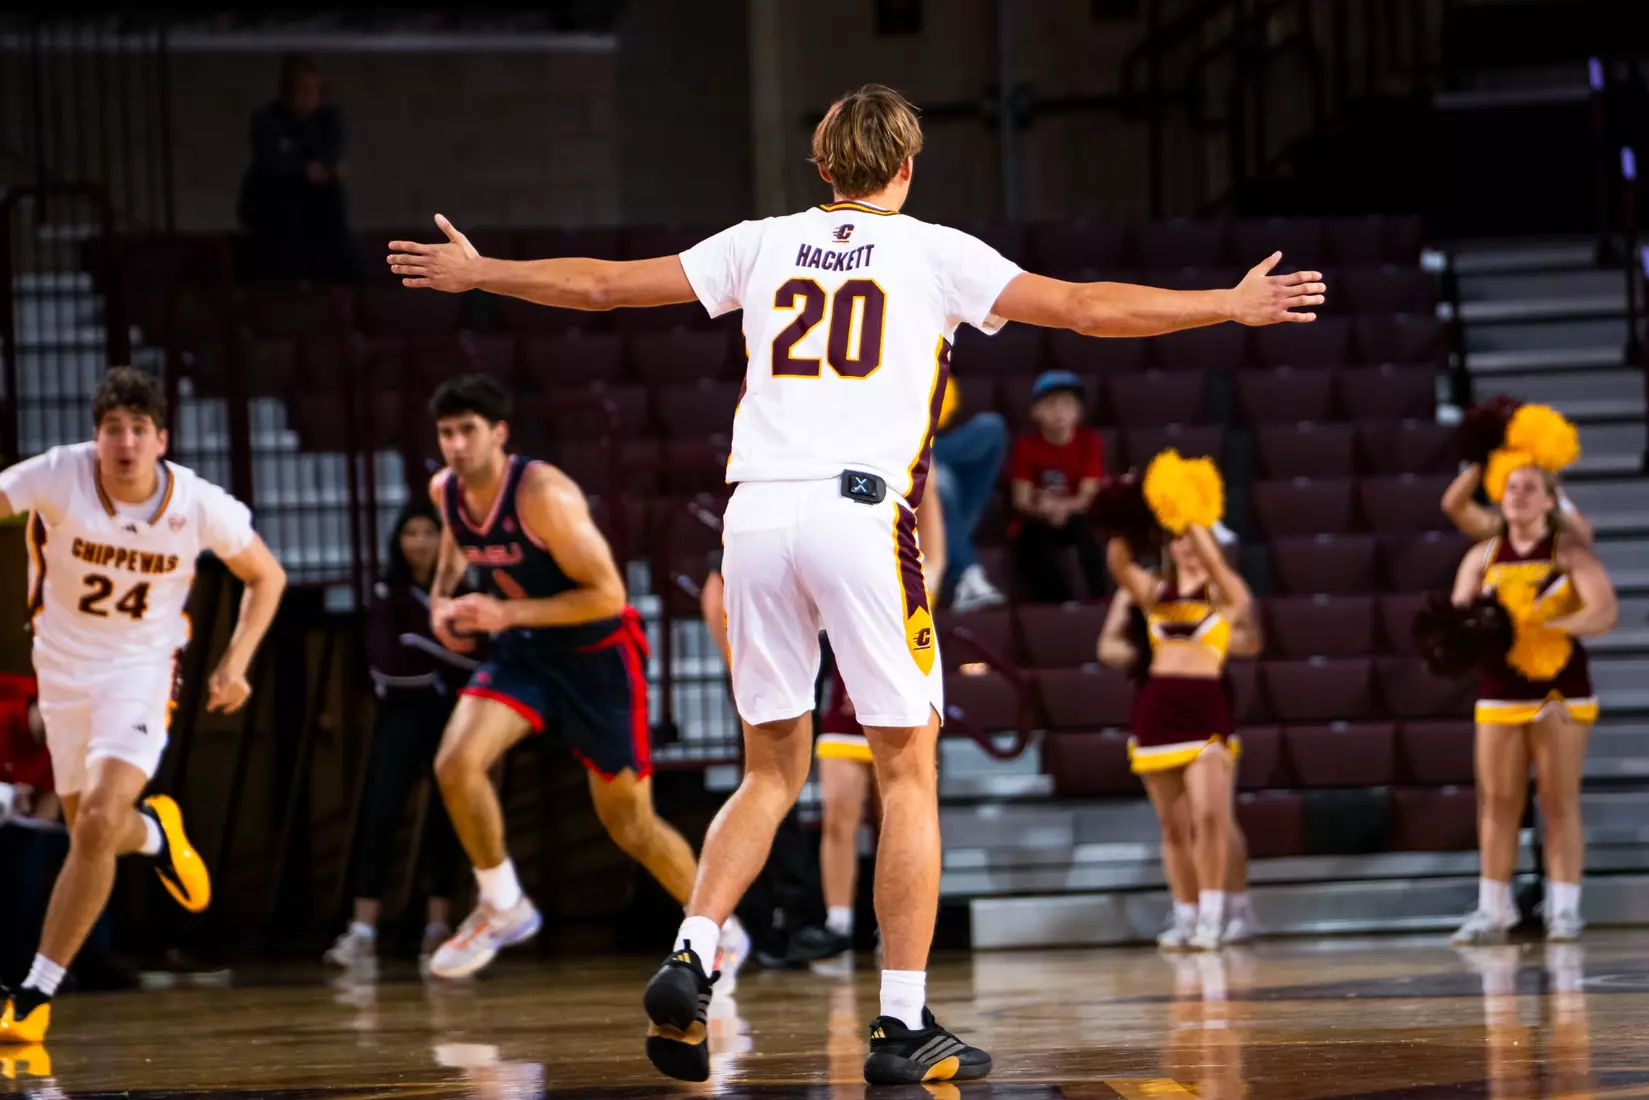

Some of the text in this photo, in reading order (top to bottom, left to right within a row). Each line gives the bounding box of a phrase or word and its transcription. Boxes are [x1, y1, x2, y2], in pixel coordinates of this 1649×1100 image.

[795, 243, 875, 272] HACKETT
[771, 277, 888, 381] 20
[71, 536, 180, 574] CHIPPEWAS
[78, 573, 152, 620] 24
